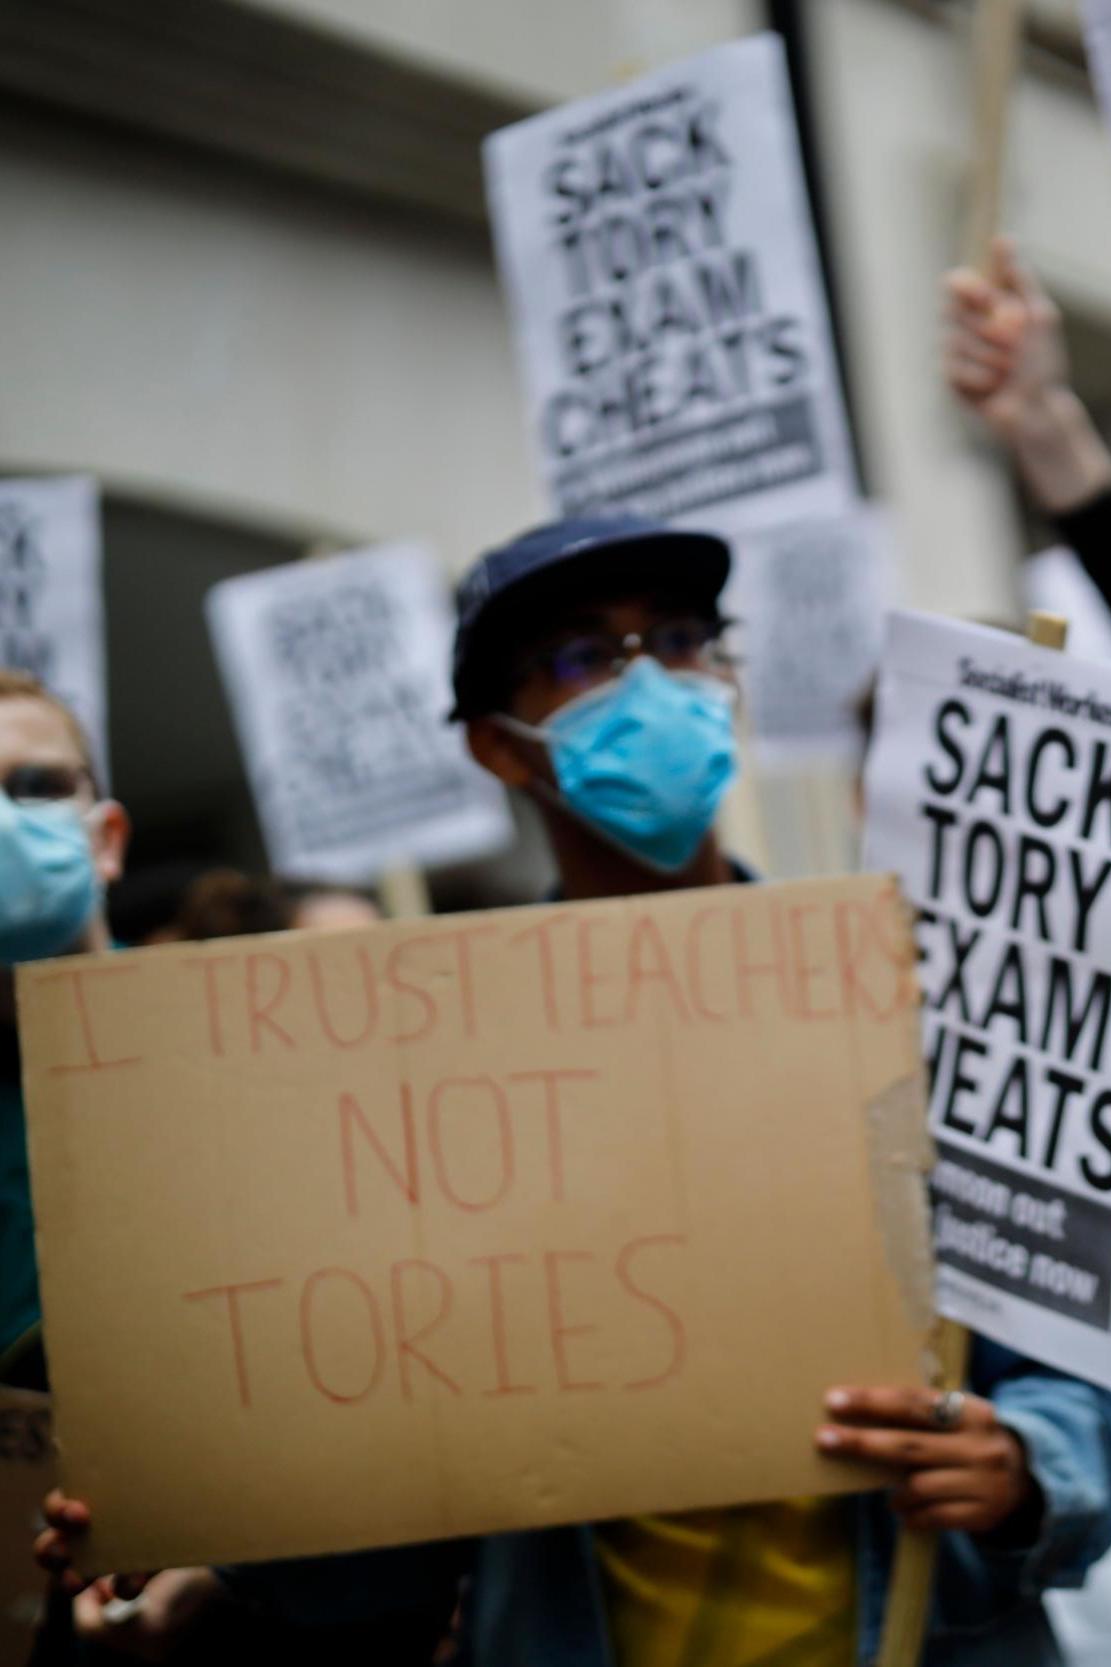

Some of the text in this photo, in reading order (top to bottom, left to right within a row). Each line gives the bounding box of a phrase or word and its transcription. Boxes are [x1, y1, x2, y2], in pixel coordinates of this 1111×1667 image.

[545, 104, 731, 226] SACK
[551, 170, 729, 297] TORY
[561, 249, 763, 377] EXAM
[543, 316, 806, 457] CHEATS
[35, 888, 916, 1076] I TRUST TEACHERS
[337, 1069, 598, 1216] NOT
[183, 1233, 688, 1407] TORIES
